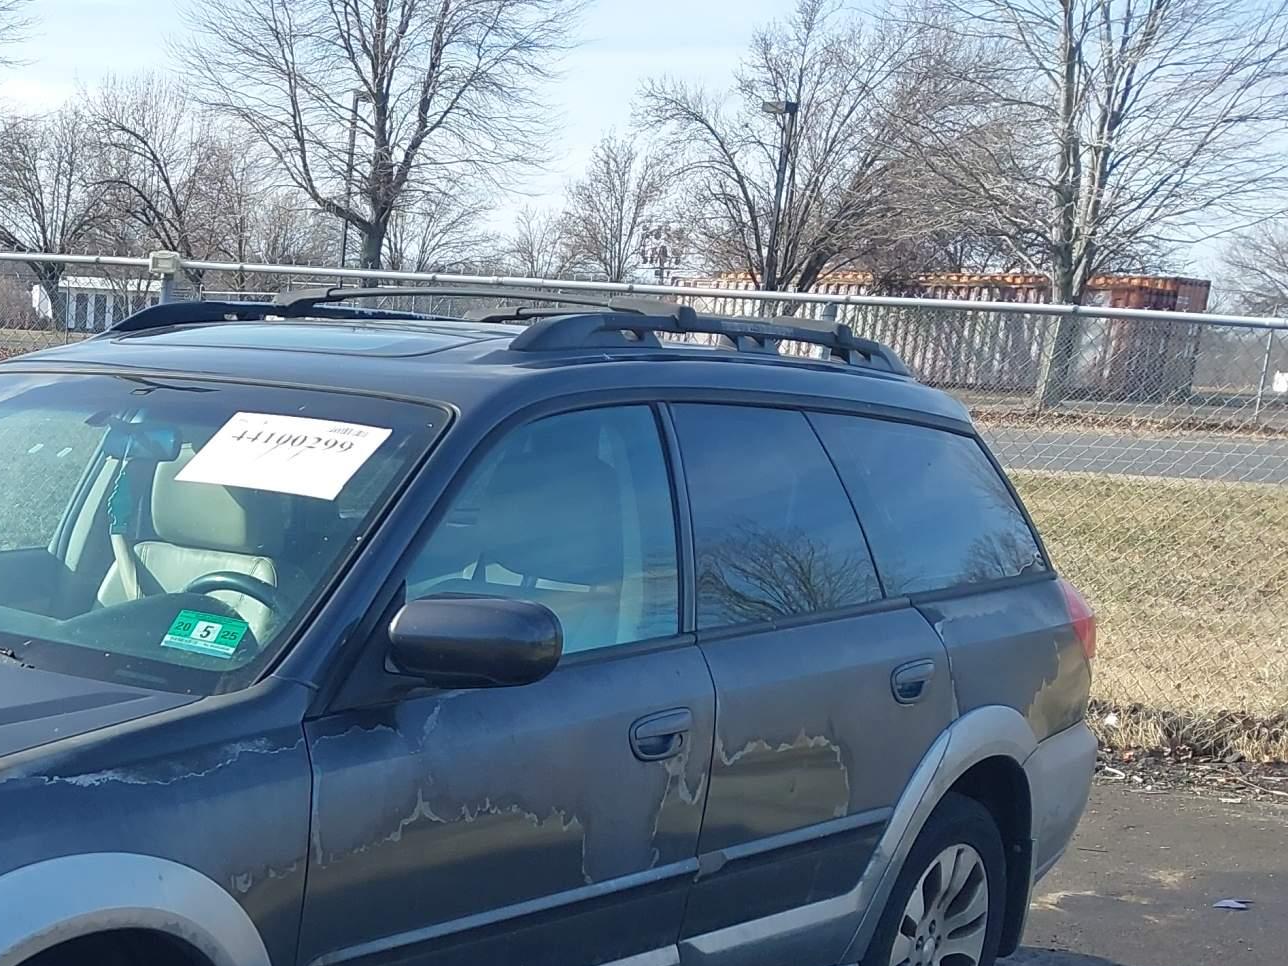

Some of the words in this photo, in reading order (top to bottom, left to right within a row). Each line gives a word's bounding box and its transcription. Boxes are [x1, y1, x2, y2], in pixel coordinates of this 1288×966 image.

[174, 621, 192, 632] 20
[199, 625, 214, 639] 5
[220, 630, 239, 641] 25
